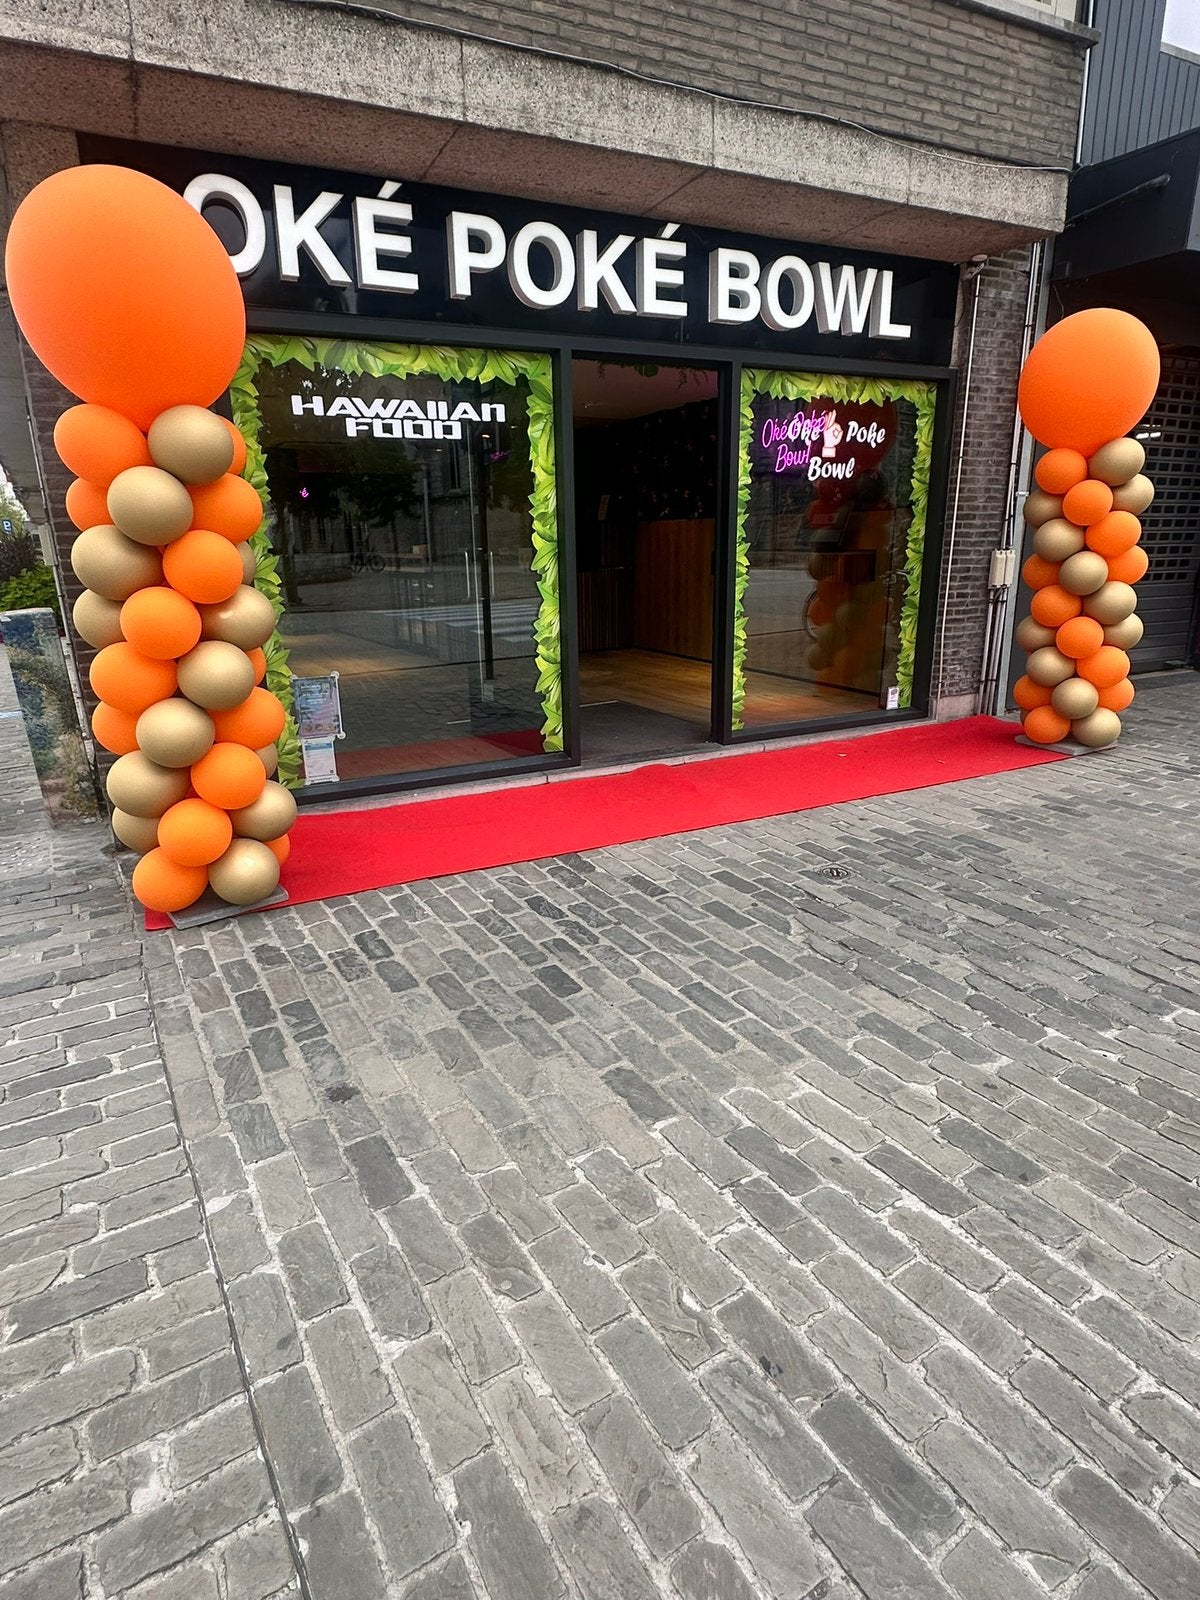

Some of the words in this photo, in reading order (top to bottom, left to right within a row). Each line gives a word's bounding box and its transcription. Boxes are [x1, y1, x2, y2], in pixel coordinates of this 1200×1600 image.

[182, 173, 419, 294] OKÉ
[446, 211, 688, 319] POKÉ
[708, 247, 911, 339] BOWL
[290, 394, 506, 422] HAWAIIAN
[345, 417, 462, 440] FOOD
[846, 421, 886, 449] Poke
[807, 456, 856, 482] Bowl
